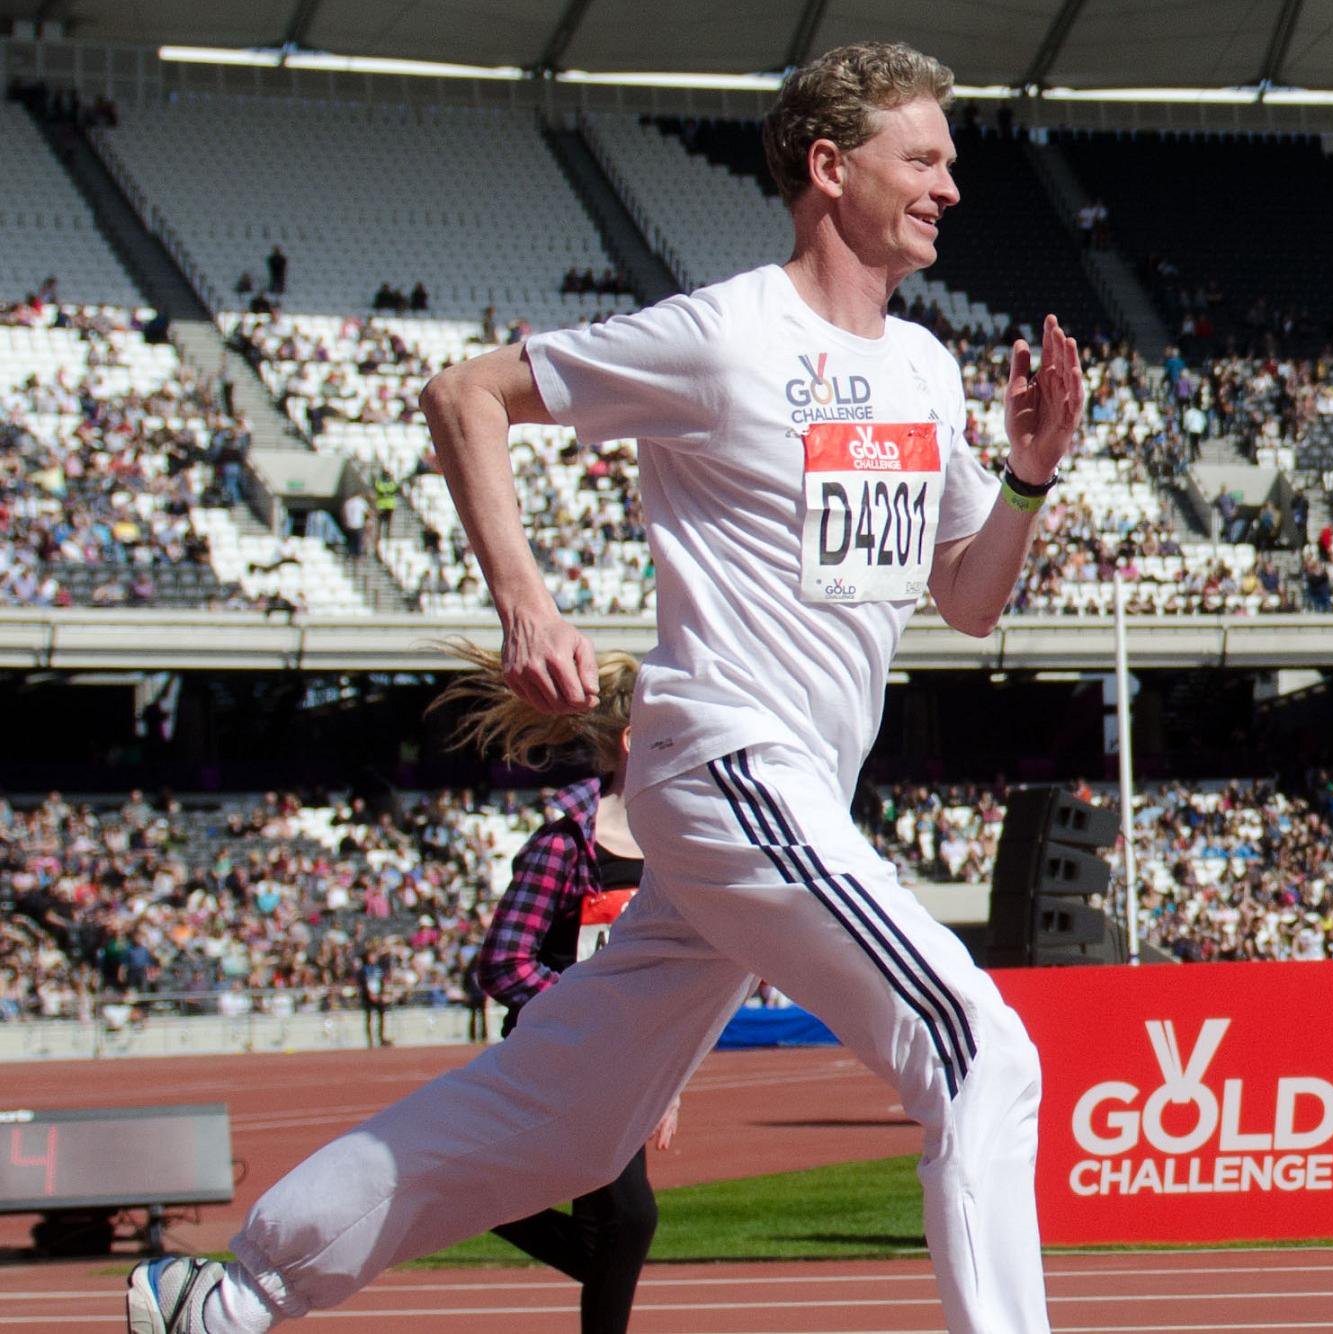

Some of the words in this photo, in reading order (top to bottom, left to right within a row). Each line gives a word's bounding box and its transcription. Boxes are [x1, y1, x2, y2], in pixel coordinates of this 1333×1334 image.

[785, 375, 872, 406] GOLD
[791, 406, 873, 423] CHALLENGE
[849, 440, 900, 459] GOLD
[853, 459, 902, 470] CHALLENGE
[819, 480, 927, 566] D4201
[825, 585, 856, 595] GOLD
